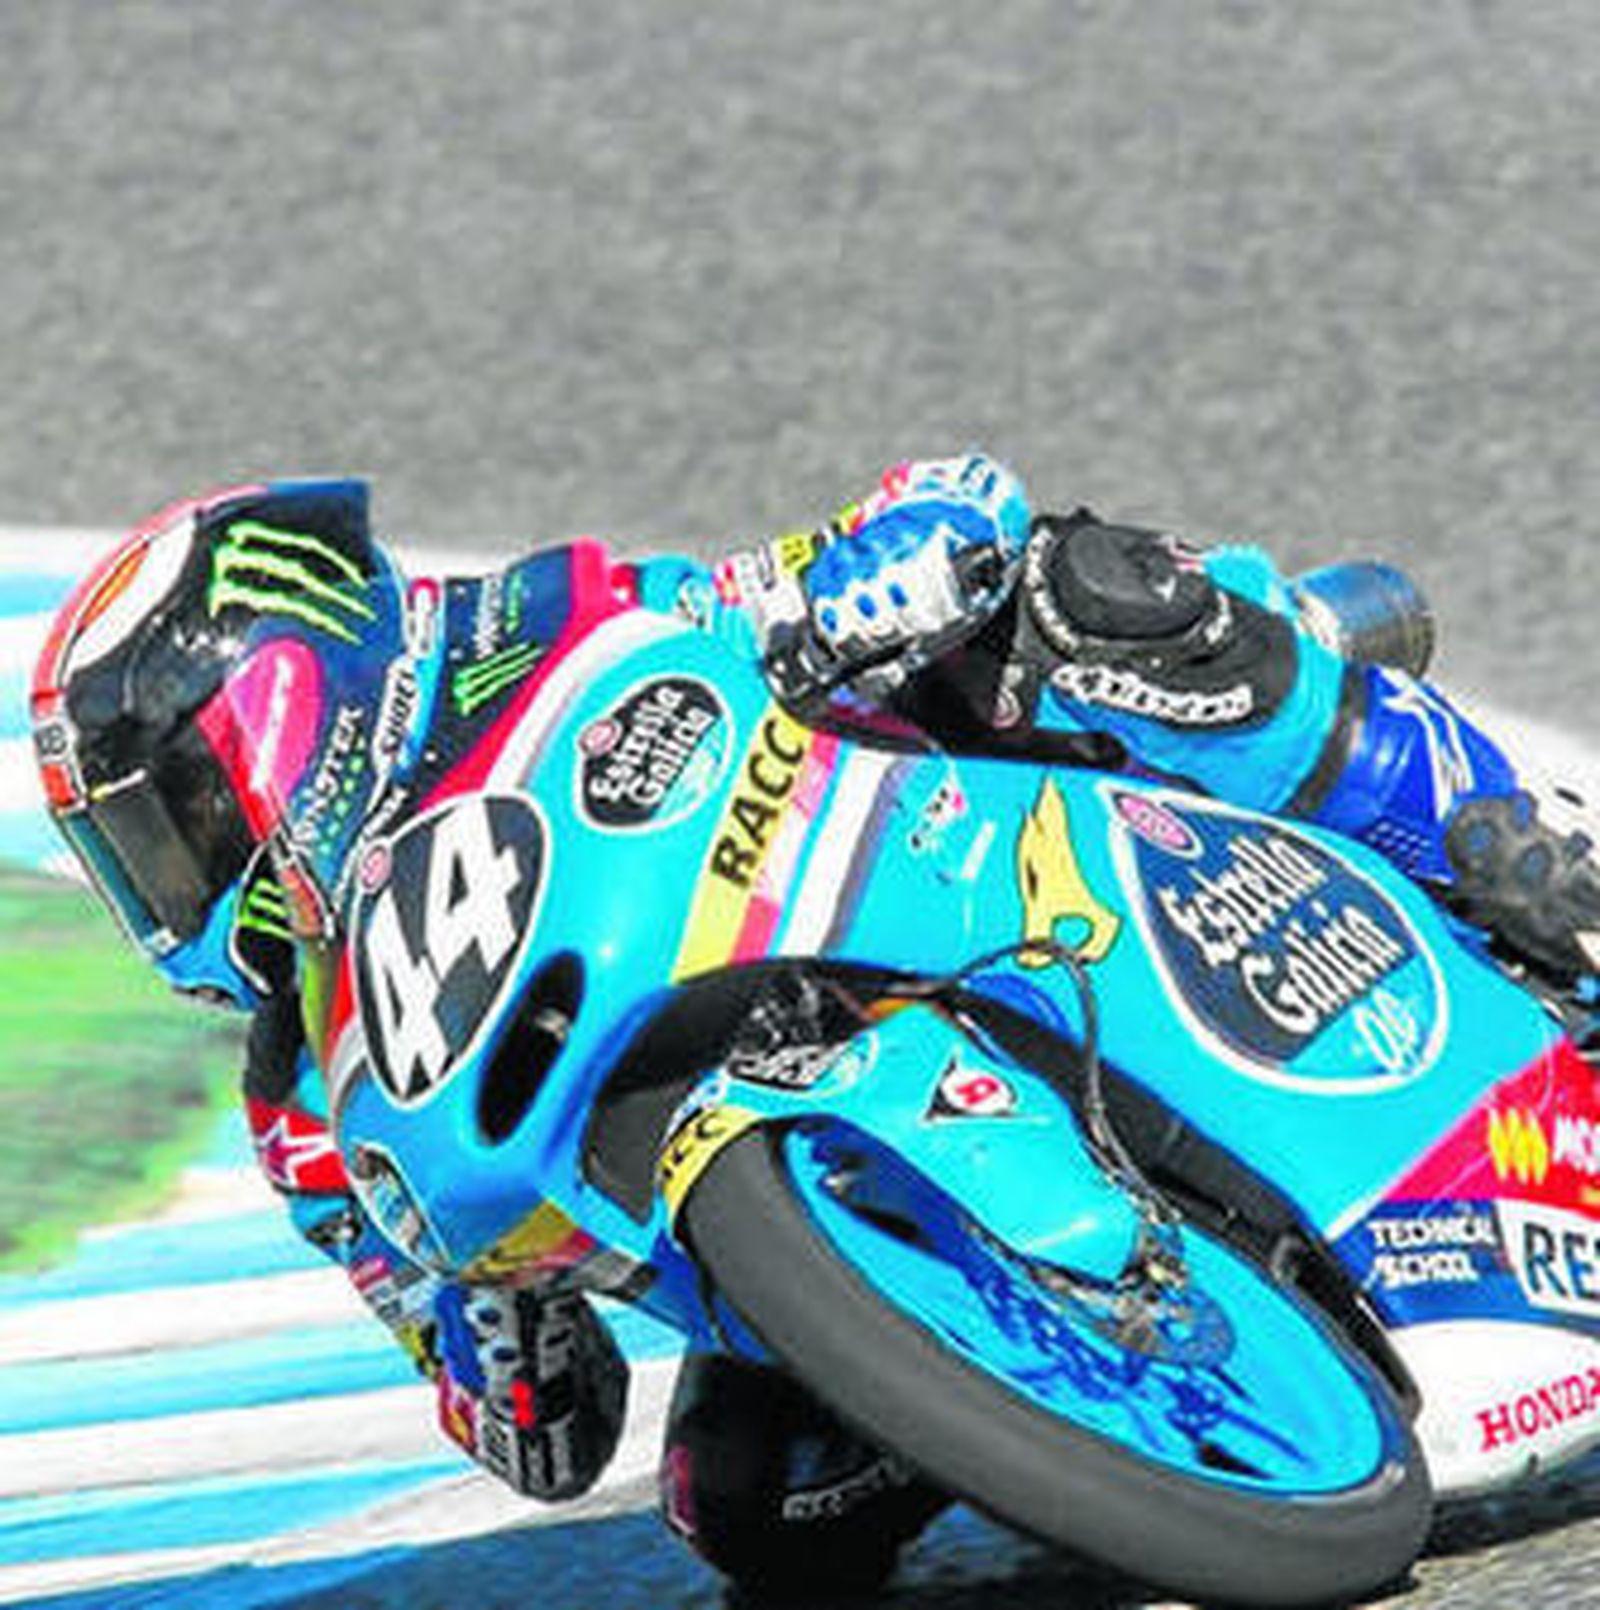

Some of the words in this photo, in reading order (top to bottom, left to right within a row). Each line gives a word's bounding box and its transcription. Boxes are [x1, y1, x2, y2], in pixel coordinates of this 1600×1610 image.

[711, 719, 803, 887] RACC
[365, 796, 522, 1095] 44
[1156, 835, 1328, 968] Estrella
[1240, 902, 1405, 1034] Galicia
